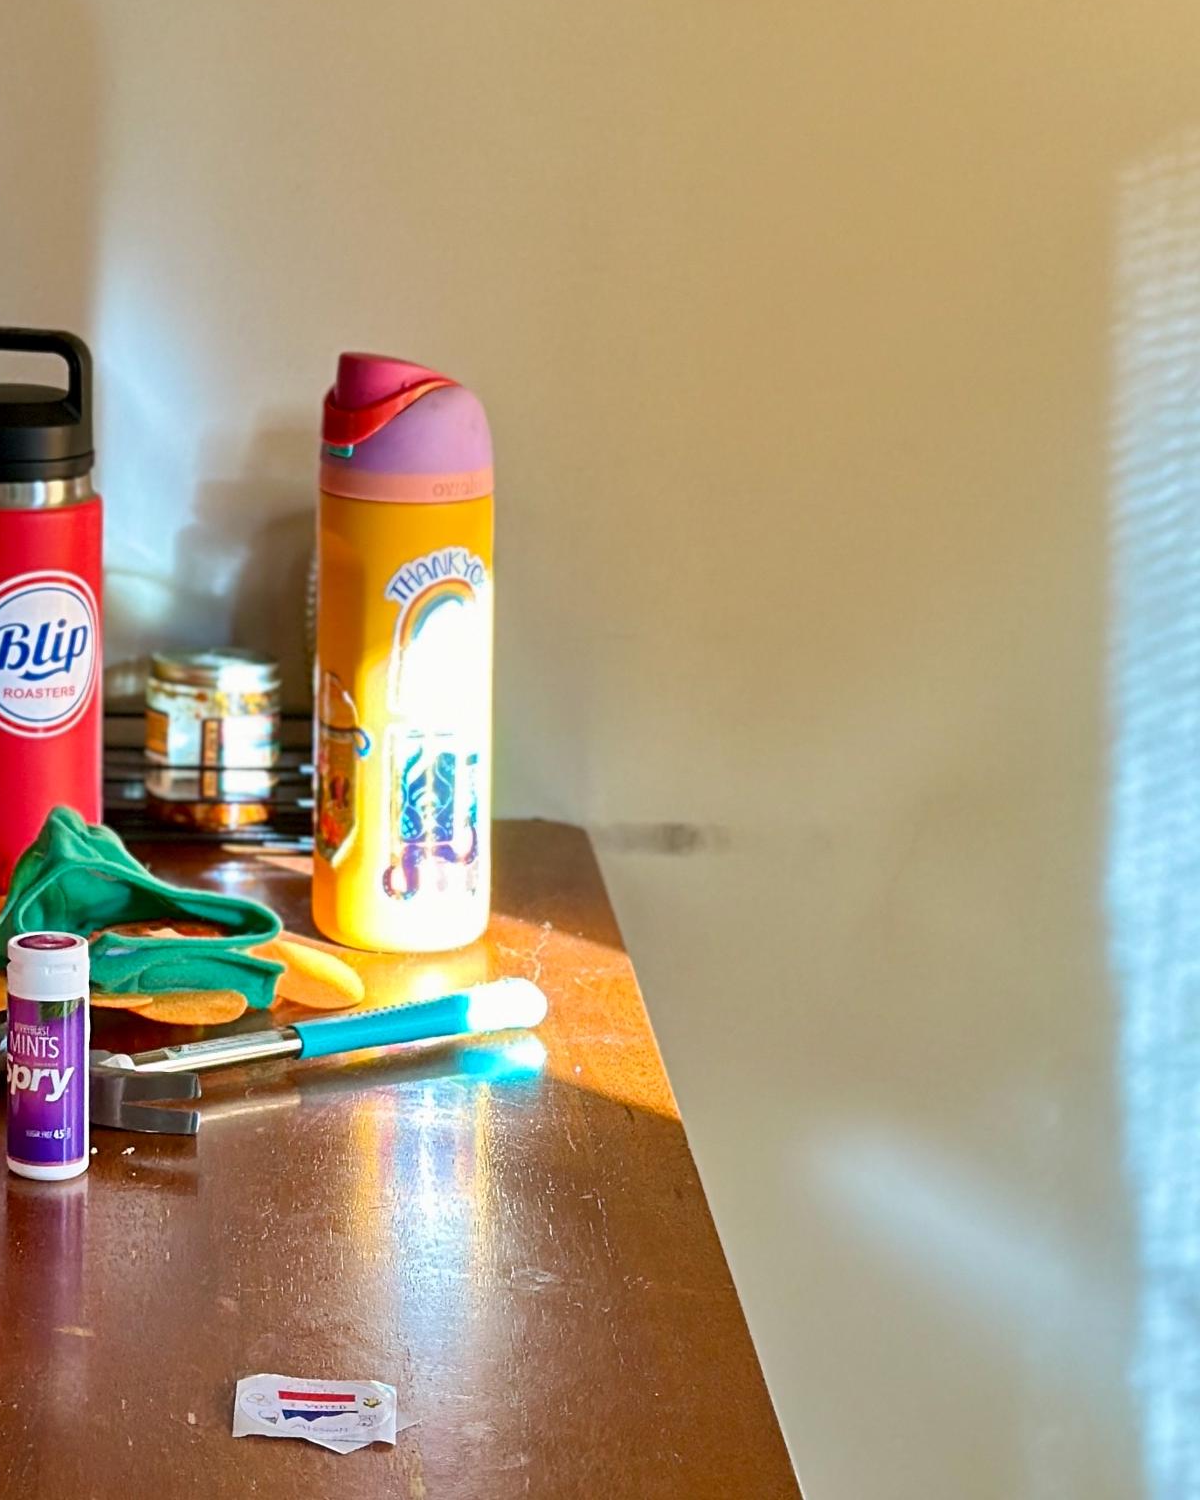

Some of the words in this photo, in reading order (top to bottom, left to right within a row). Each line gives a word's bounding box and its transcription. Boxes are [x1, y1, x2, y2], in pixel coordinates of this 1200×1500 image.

[3, 685, 76, 699] ROASTERS
[10, 1030, 60, 1059] MINTS
[7, 1053, 75, 1102] Spry
